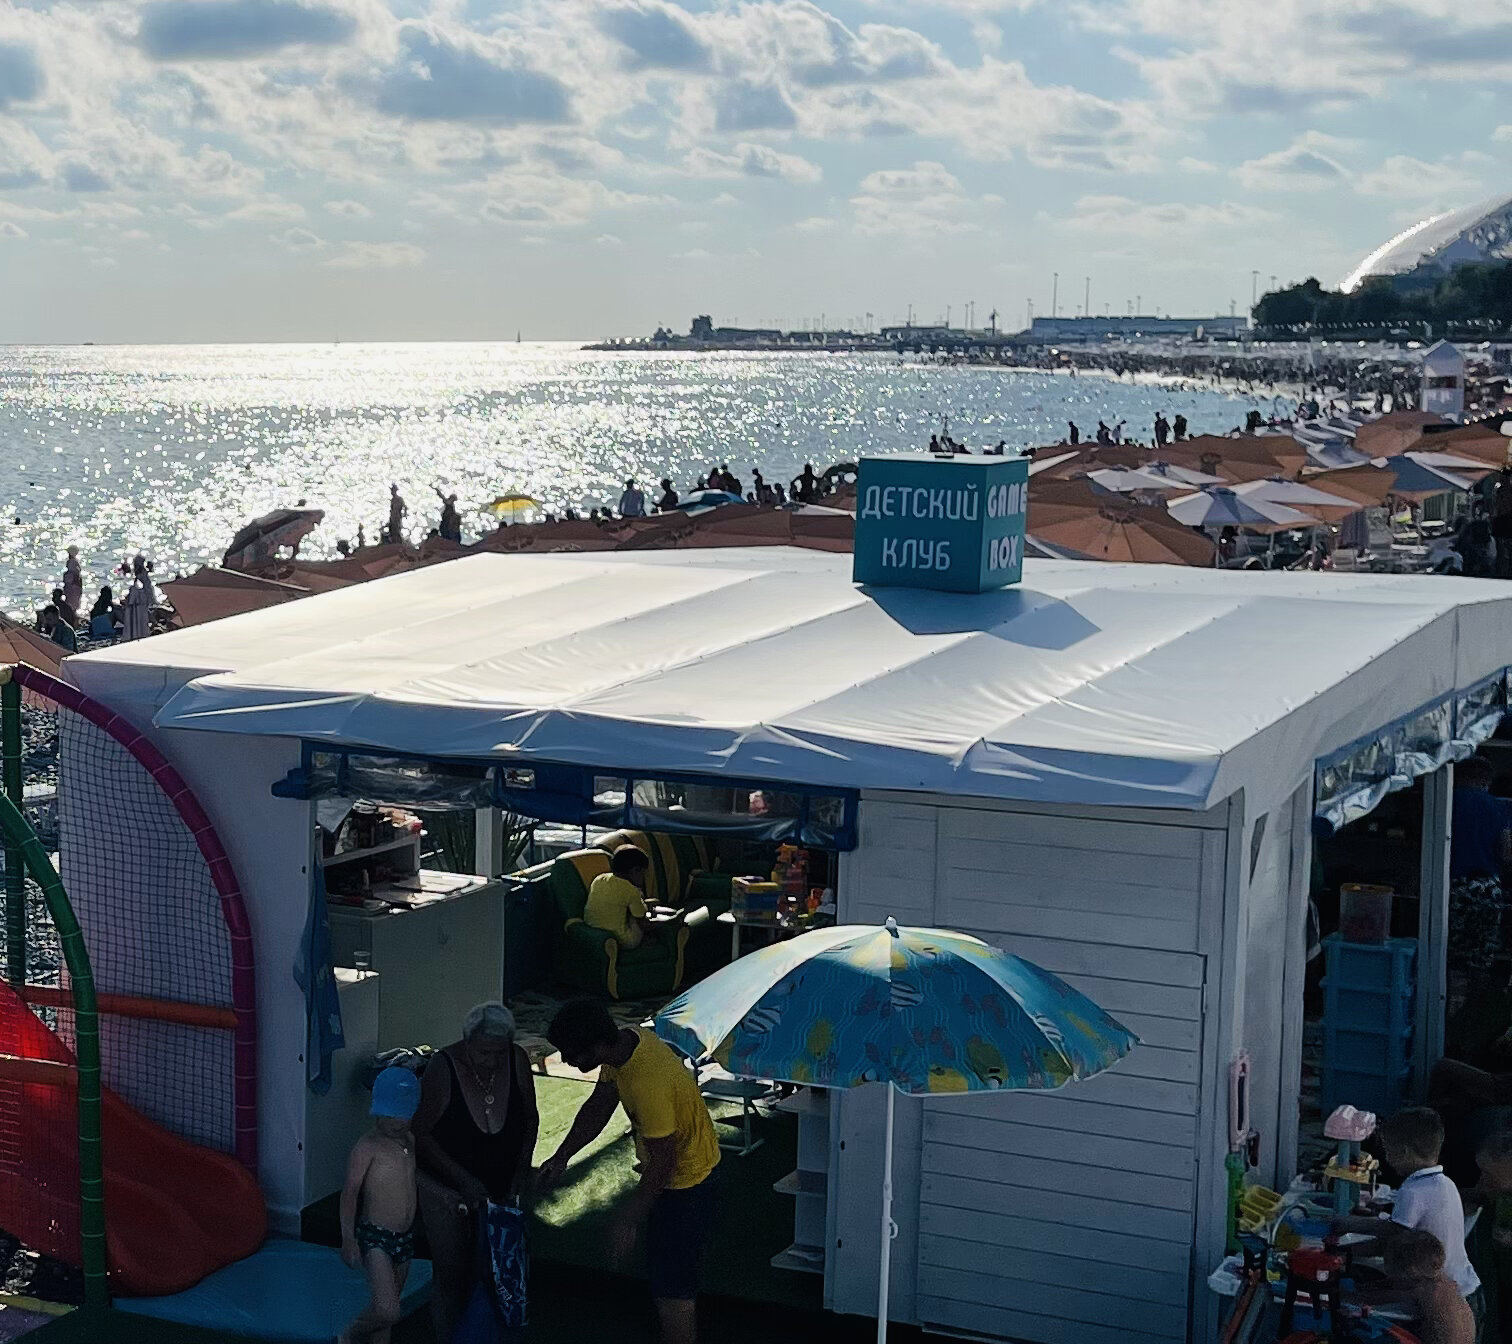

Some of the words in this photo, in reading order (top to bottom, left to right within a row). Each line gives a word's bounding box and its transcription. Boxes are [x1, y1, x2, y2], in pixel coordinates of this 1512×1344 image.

[861, 482, 979, 521] ДЕТСКИЙ
[987, 481, 1028, 519] GAME
[881, 537, 951, 571] КЛУБ
[989, 535, 1019, 571] BOX
